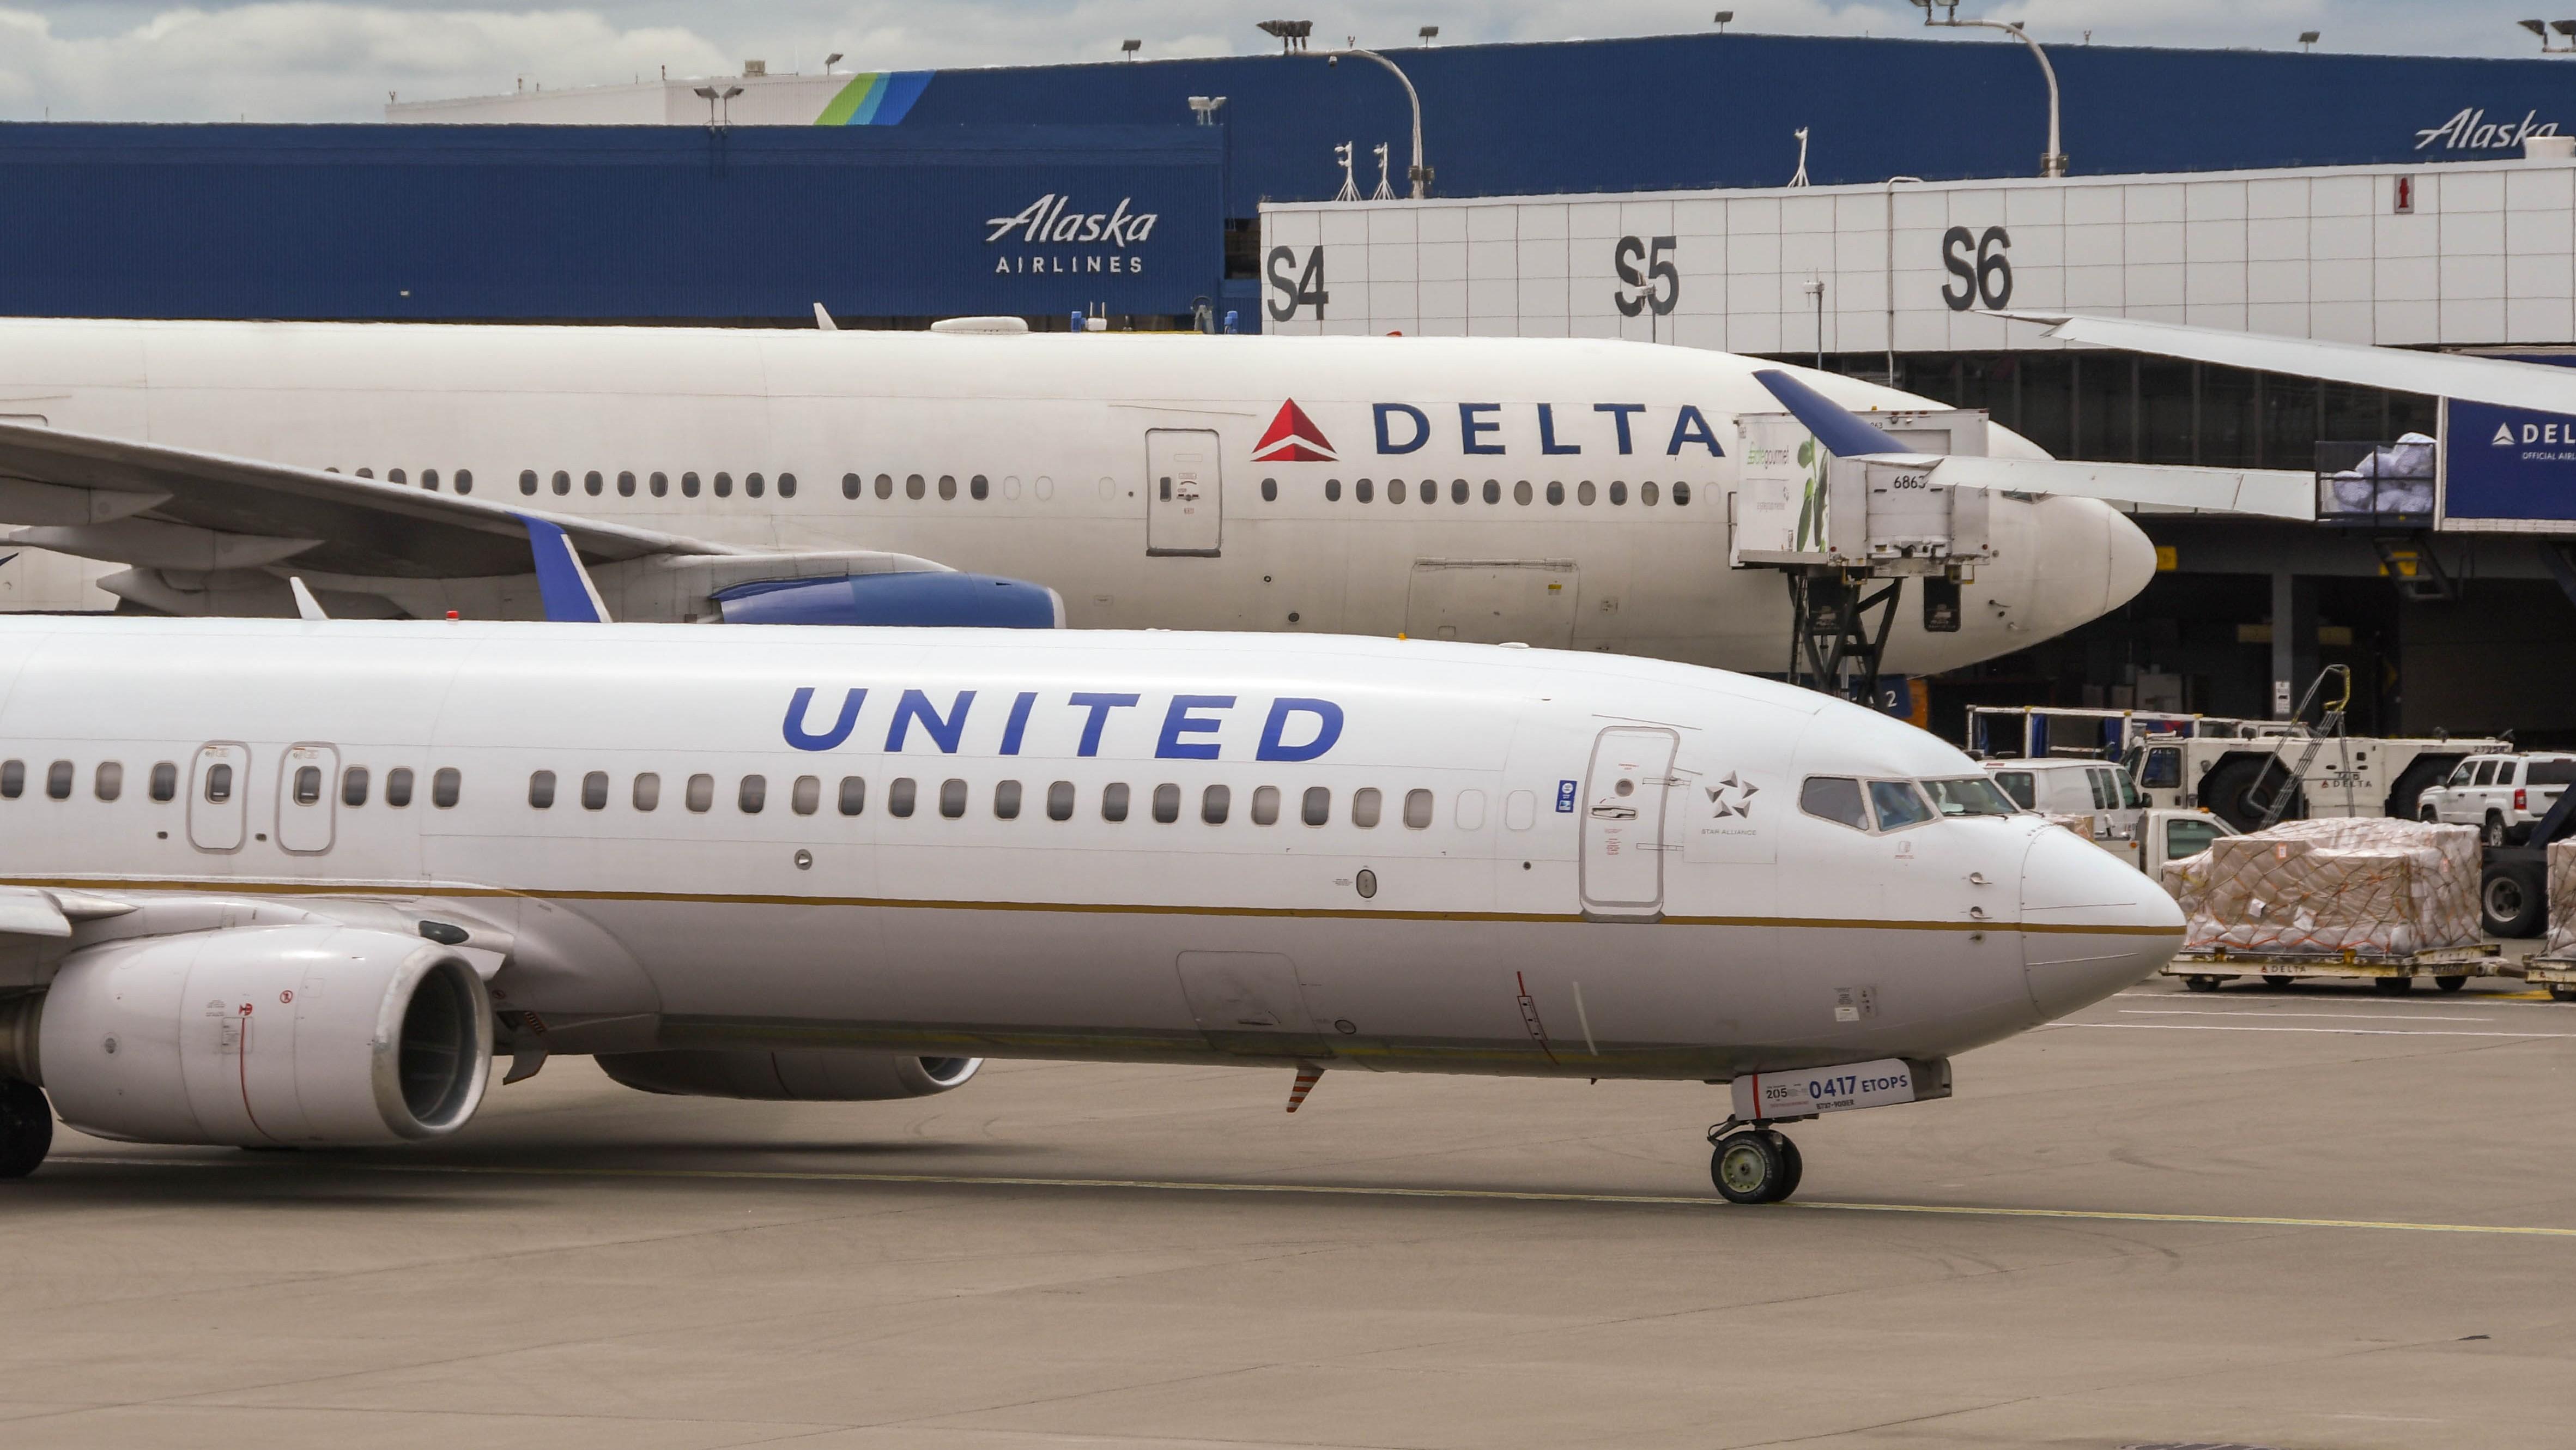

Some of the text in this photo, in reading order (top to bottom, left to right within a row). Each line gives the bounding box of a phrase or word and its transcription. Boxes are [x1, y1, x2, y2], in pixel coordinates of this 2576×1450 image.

[2415, 107, 2559, 150] Alaska
[985, 194, 1158, 247] Alaska
[995, 256, 1142, 273] AIRLINES
[1267, 245, 1329, 322] S4
[1615, 235, 1680, 317] S5
[1942, 226, 2013, 311] S6
[1372, 402, 1726, 457] DELTA
[2522, 423, 2576, 444] DEL
[2522, 451, 2556, 461] OFFICIAL
[1894, 475, 1927, 489] 6863
[1886, 690, 1898, 708] 2
[781, 686, 1345, 762] UNITED
[1766, 1074, 1908, 1099] 205 0417 ETOPS
